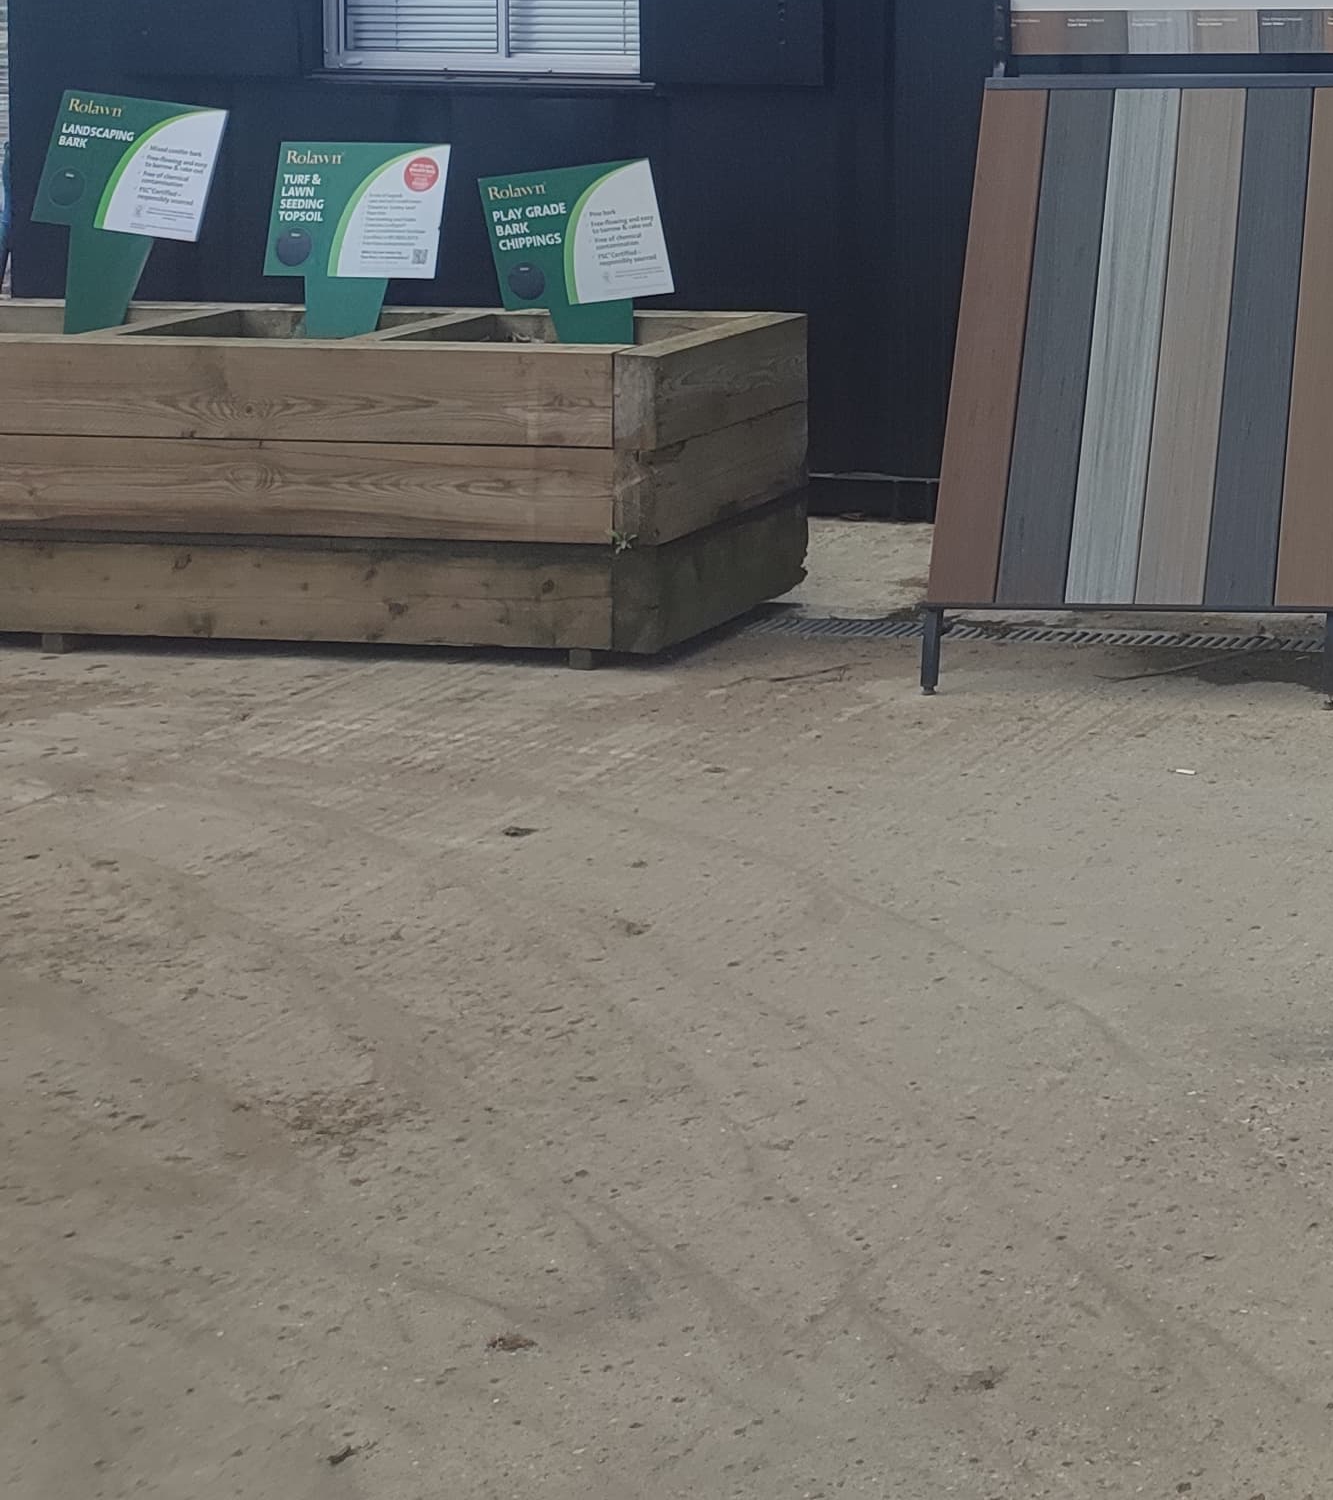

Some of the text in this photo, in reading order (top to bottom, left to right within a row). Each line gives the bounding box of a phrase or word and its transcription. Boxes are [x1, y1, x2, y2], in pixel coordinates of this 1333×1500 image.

[62, 123, 134, 142] LANDSCAPING
[58, 136, 88, 148] BARK
[283, 174, 321, 185] TURF &
[281, 187, 314, 197] LAWN
[280, 199, 325, 209] SEEDING
[278, 211, 323, 222] TOPSOIL
[492, 202, 567, 222] PLAY GRADE
[496, 222, 529, 236] BARK
[499, 233, 562, 251] CHIPPINGS
